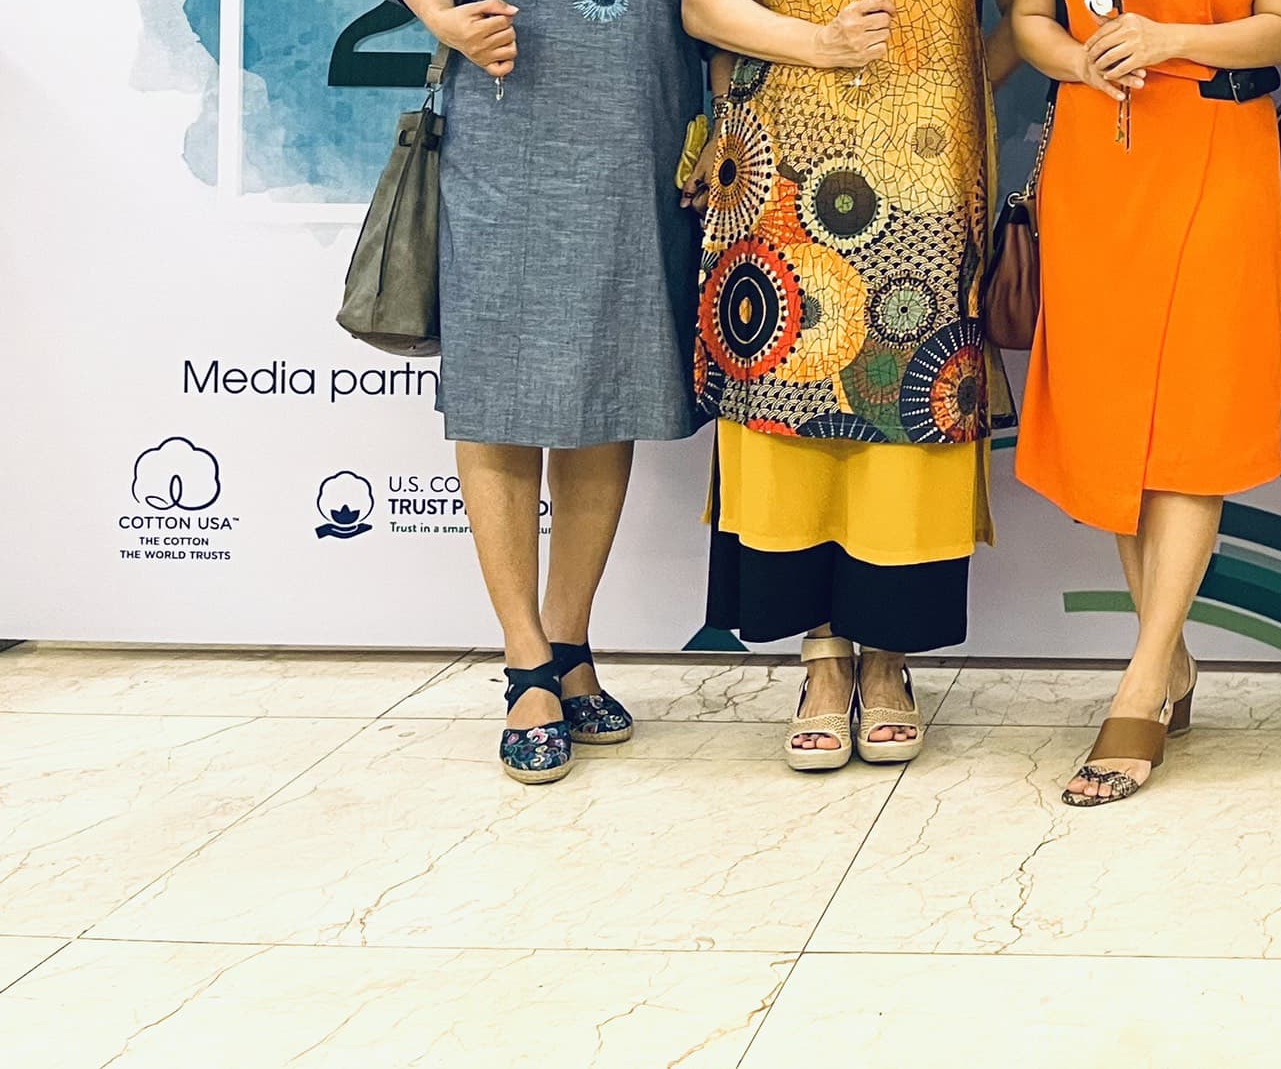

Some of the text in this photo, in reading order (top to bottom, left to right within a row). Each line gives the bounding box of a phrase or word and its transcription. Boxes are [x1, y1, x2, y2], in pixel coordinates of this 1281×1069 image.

[183, 359, 439, 404] Media partn
[389, 476, 424, 493] U.S.
[387, 498, 449, 516] TRUST
[118, 515, 191, 530] COTTON
[389, 521, 417, 533] Trust
[420, 522, 431, 533] in
[433, 525, 440, 533] a
[139, 536, 209, 546] THE COTTON
[119, 549, 231, 560] THE WORLD TRUSTS
